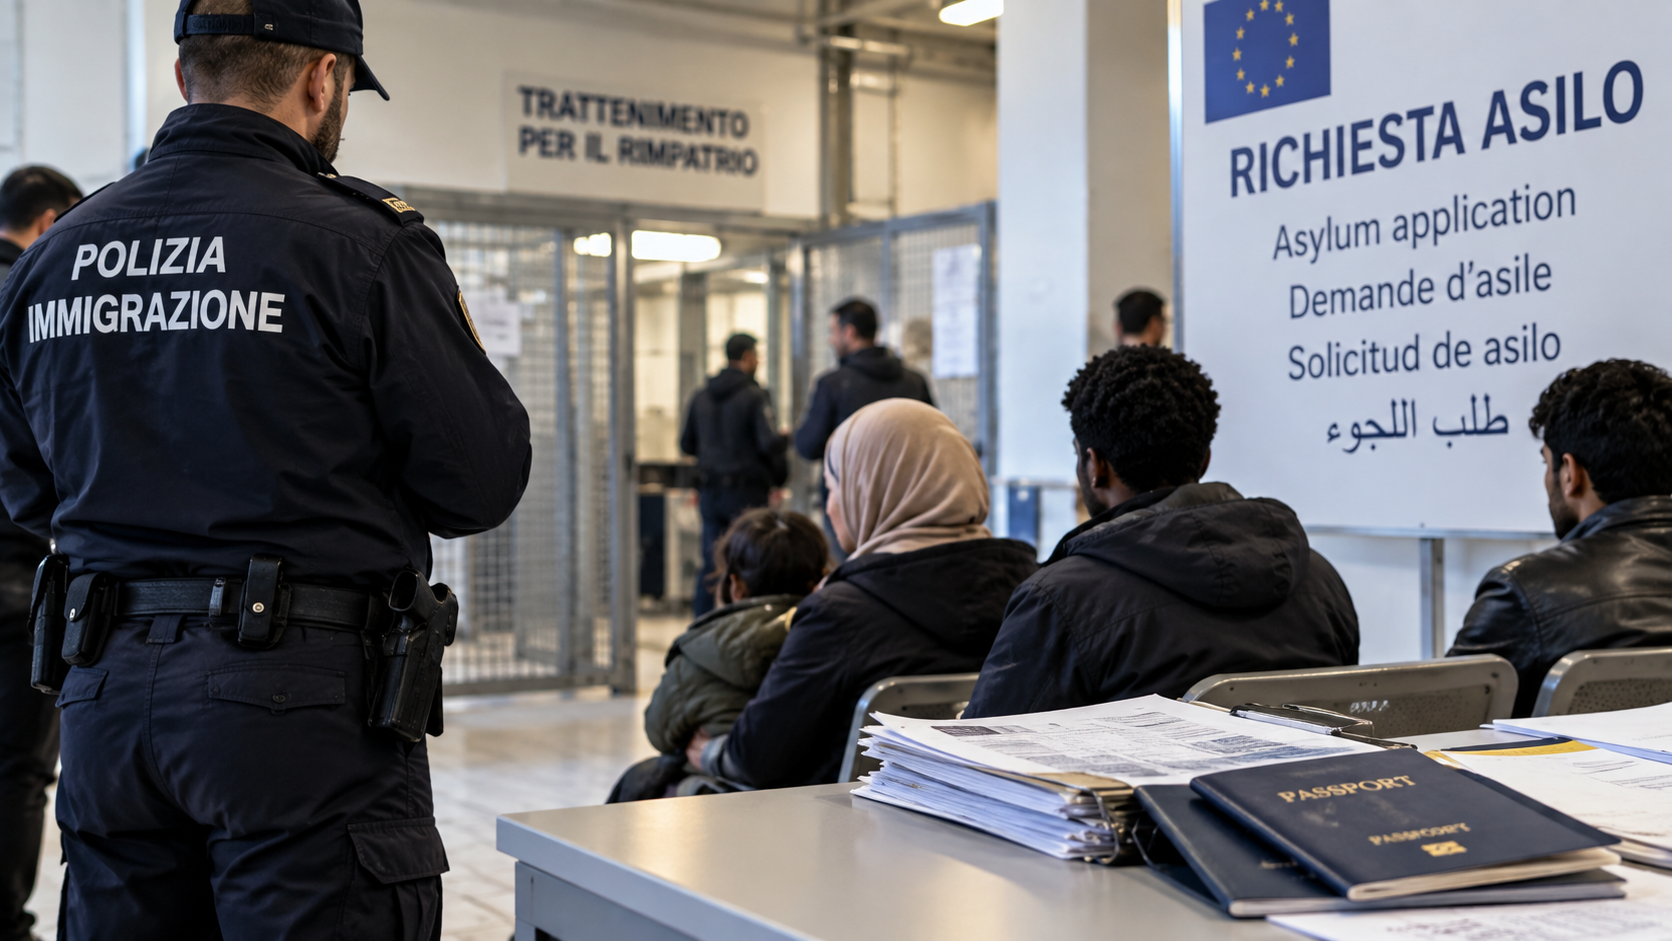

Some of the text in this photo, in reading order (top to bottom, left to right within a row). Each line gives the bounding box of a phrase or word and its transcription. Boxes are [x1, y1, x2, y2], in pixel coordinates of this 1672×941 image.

[517, 85, 749, 139] TRATTENIMENTO
[1230, 60, 1644, 198] RICHIESTA ASILO
[518, 126, 759, 177] PER IL RIMPATRIO
[1273, 184, 1577, 264] Asylum application
[71, 236, 226, 281] POLIZIA
[1289, 253, 1552, 319] Demande d’asile
[28, 289, 286, 343] IMMIGRAZIONE
[1288, 322, 1562, 380] Solicitud de asilo
[1327, 393, 1509, 454] طلب اللجوء
[1277, 775, 1416, 803] PASSPORT
